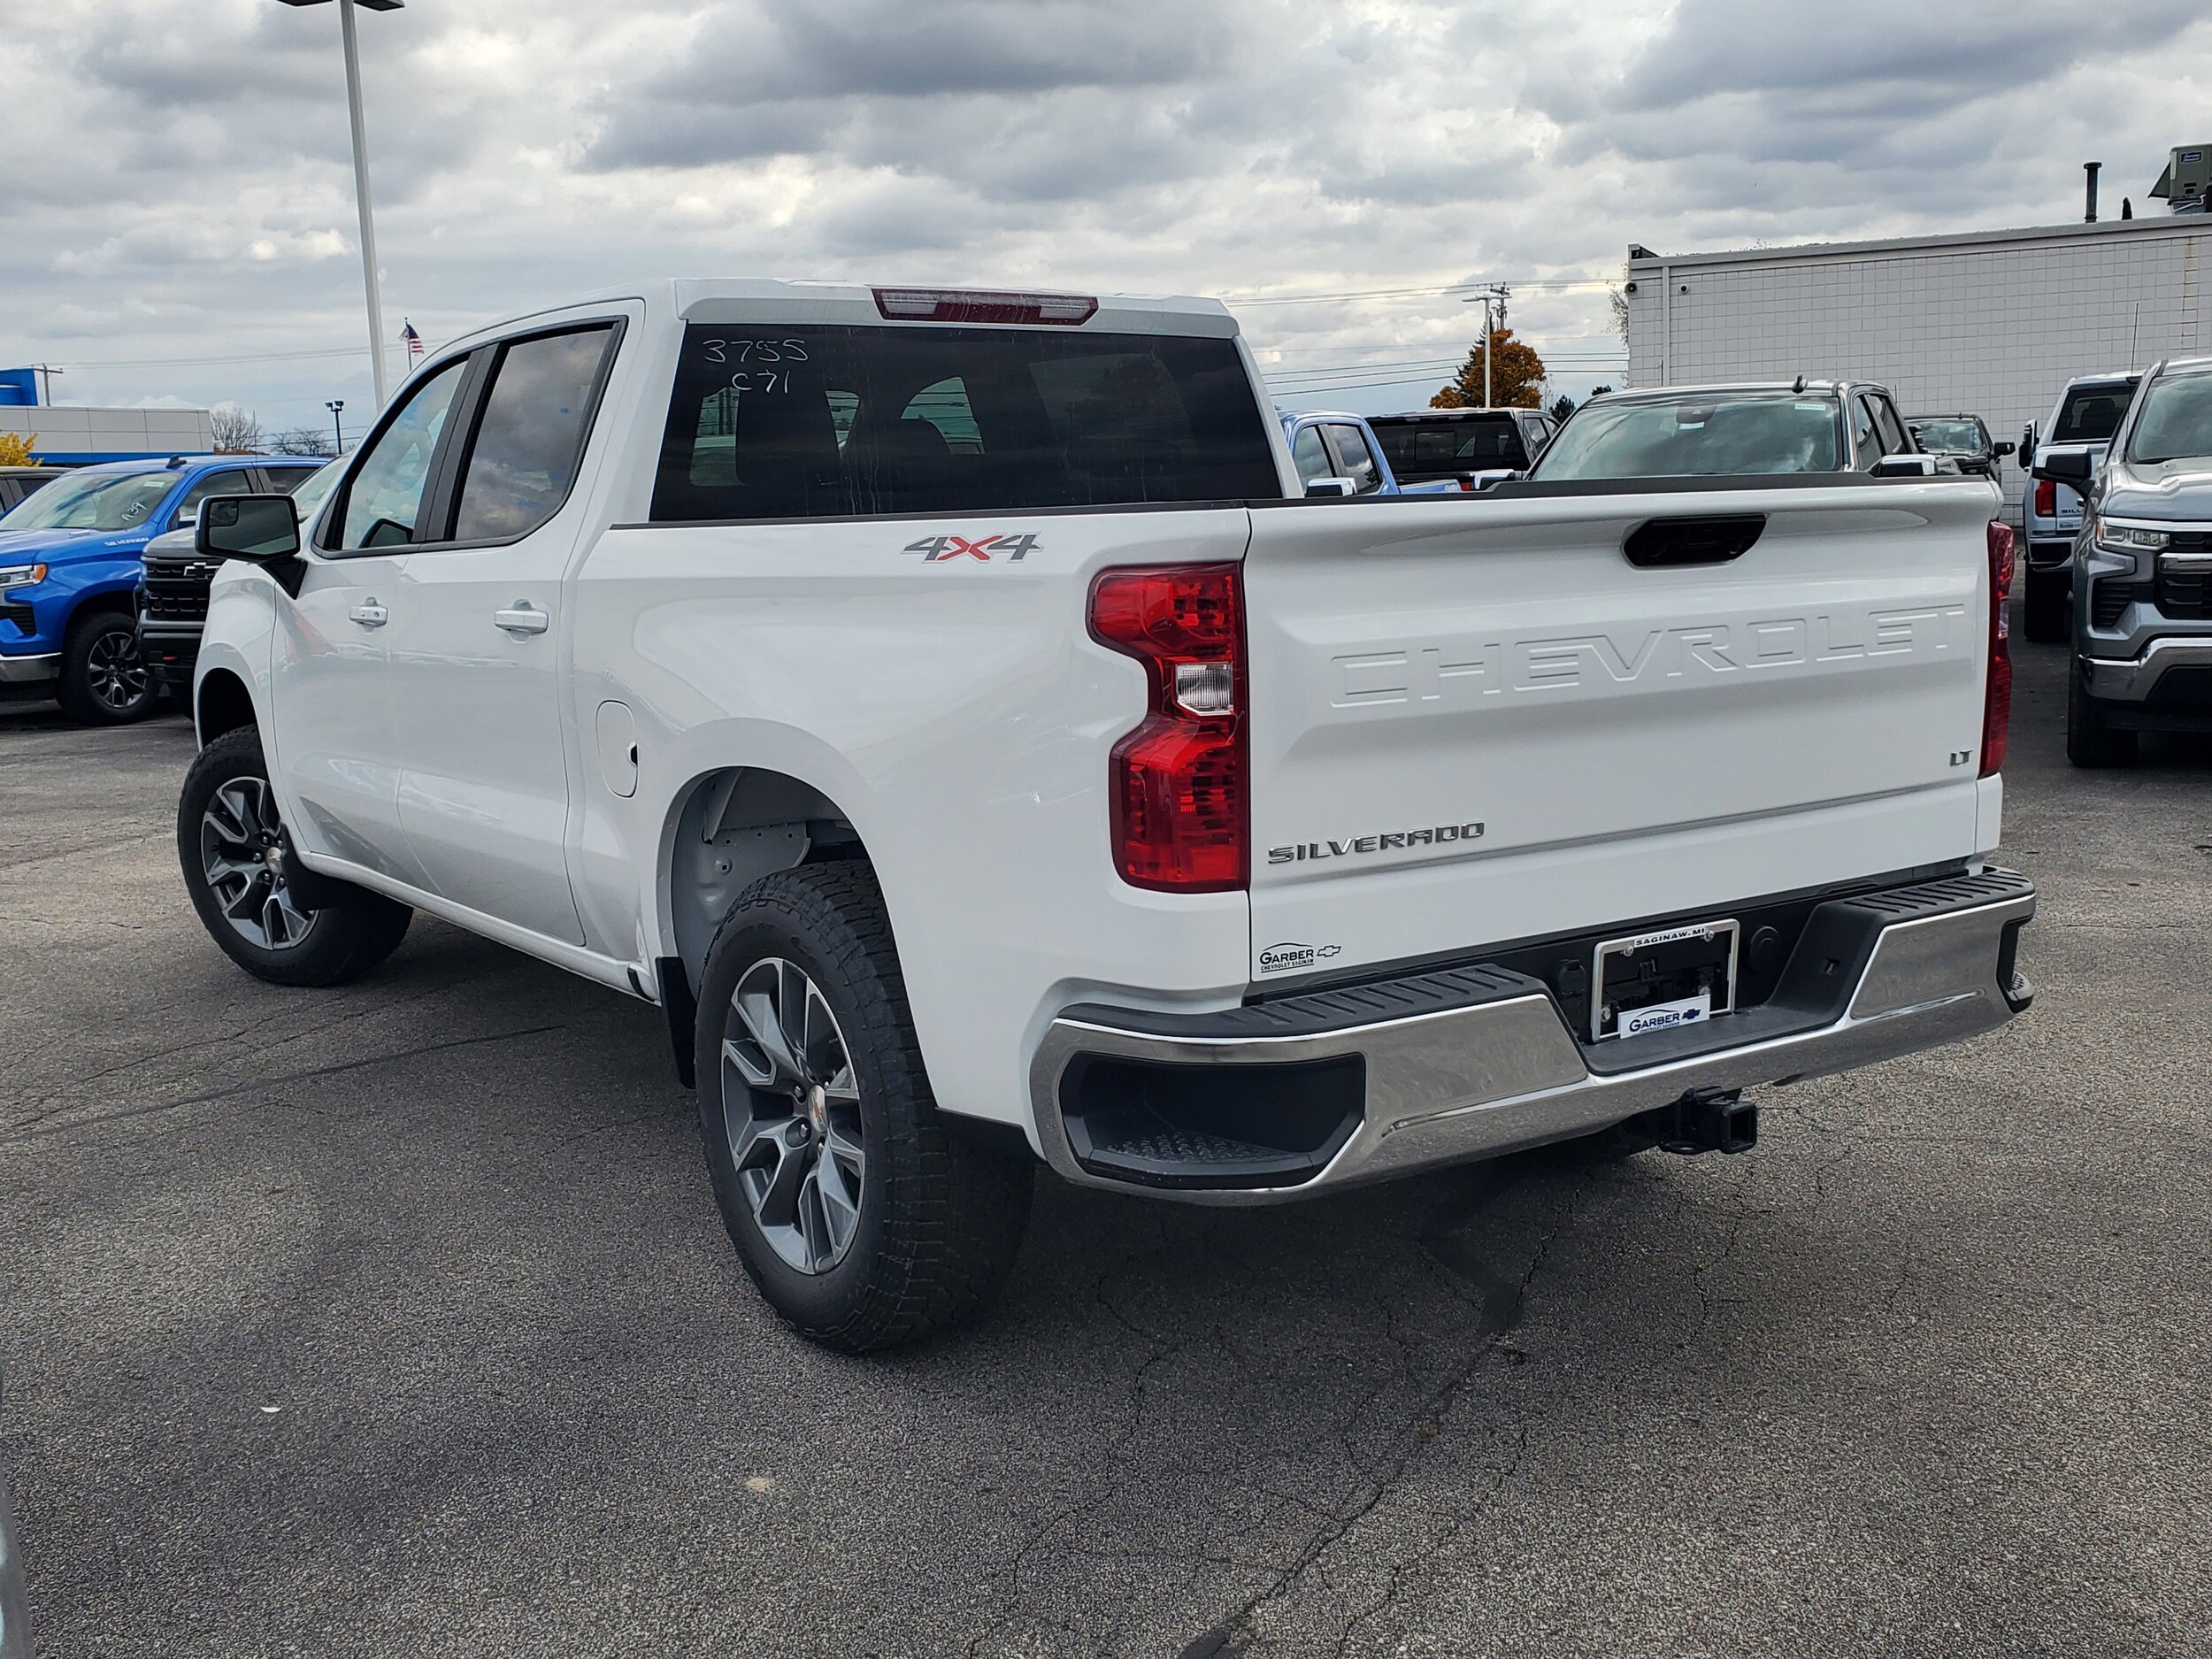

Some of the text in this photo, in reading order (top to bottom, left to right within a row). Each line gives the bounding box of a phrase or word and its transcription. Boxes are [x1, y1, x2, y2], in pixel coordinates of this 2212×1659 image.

[902, 534, 1042, 563] 4X4
[1330, 603, 1965, 708] CHEVROLET
[1949, 749, 1974, 766] LT
[1268, 822, 1486, 864] SILVERADO
[1259, 949, 1315, 965] GARBER
[1260, 961, 1291, 972] CHEVROLET
[1629, 1012, 1680, 1033] GARBER
